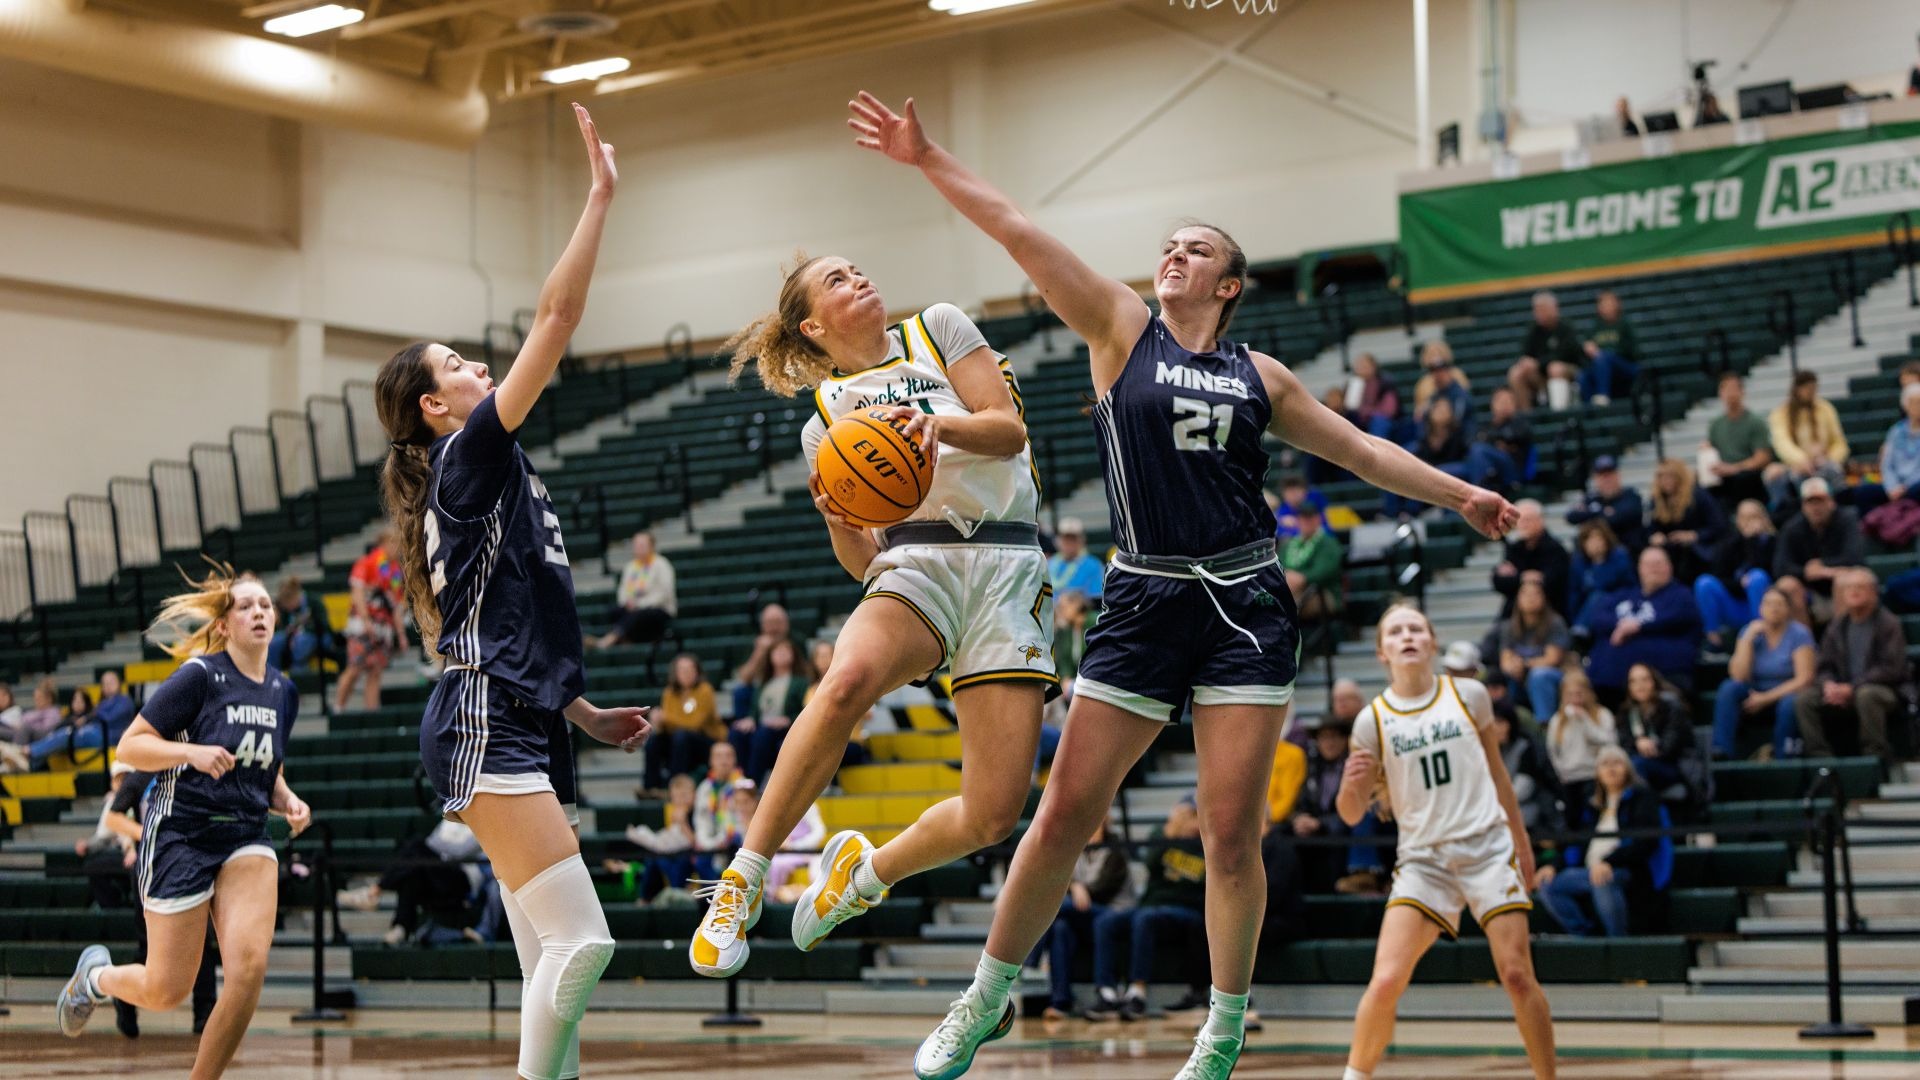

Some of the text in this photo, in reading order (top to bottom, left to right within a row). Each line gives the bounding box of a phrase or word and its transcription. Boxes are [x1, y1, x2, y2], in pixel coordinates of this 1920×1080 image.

[1500, 184, 1685, 250] WELCOME
[1691, 177, 1743, 223] TO
[1770, 159, 1837, 216] A2
[1155, 361, 1248, 399] MINES
[1172, 396, 1234, 452] 21
[853, 439, 897, 478] EVO
[226, 704, 277, 729] MINES
[236, 730, 274, 771] 44
[1391, 719, 1462, 757] Black Hills
[1419, 749, 1451, 790] 10
